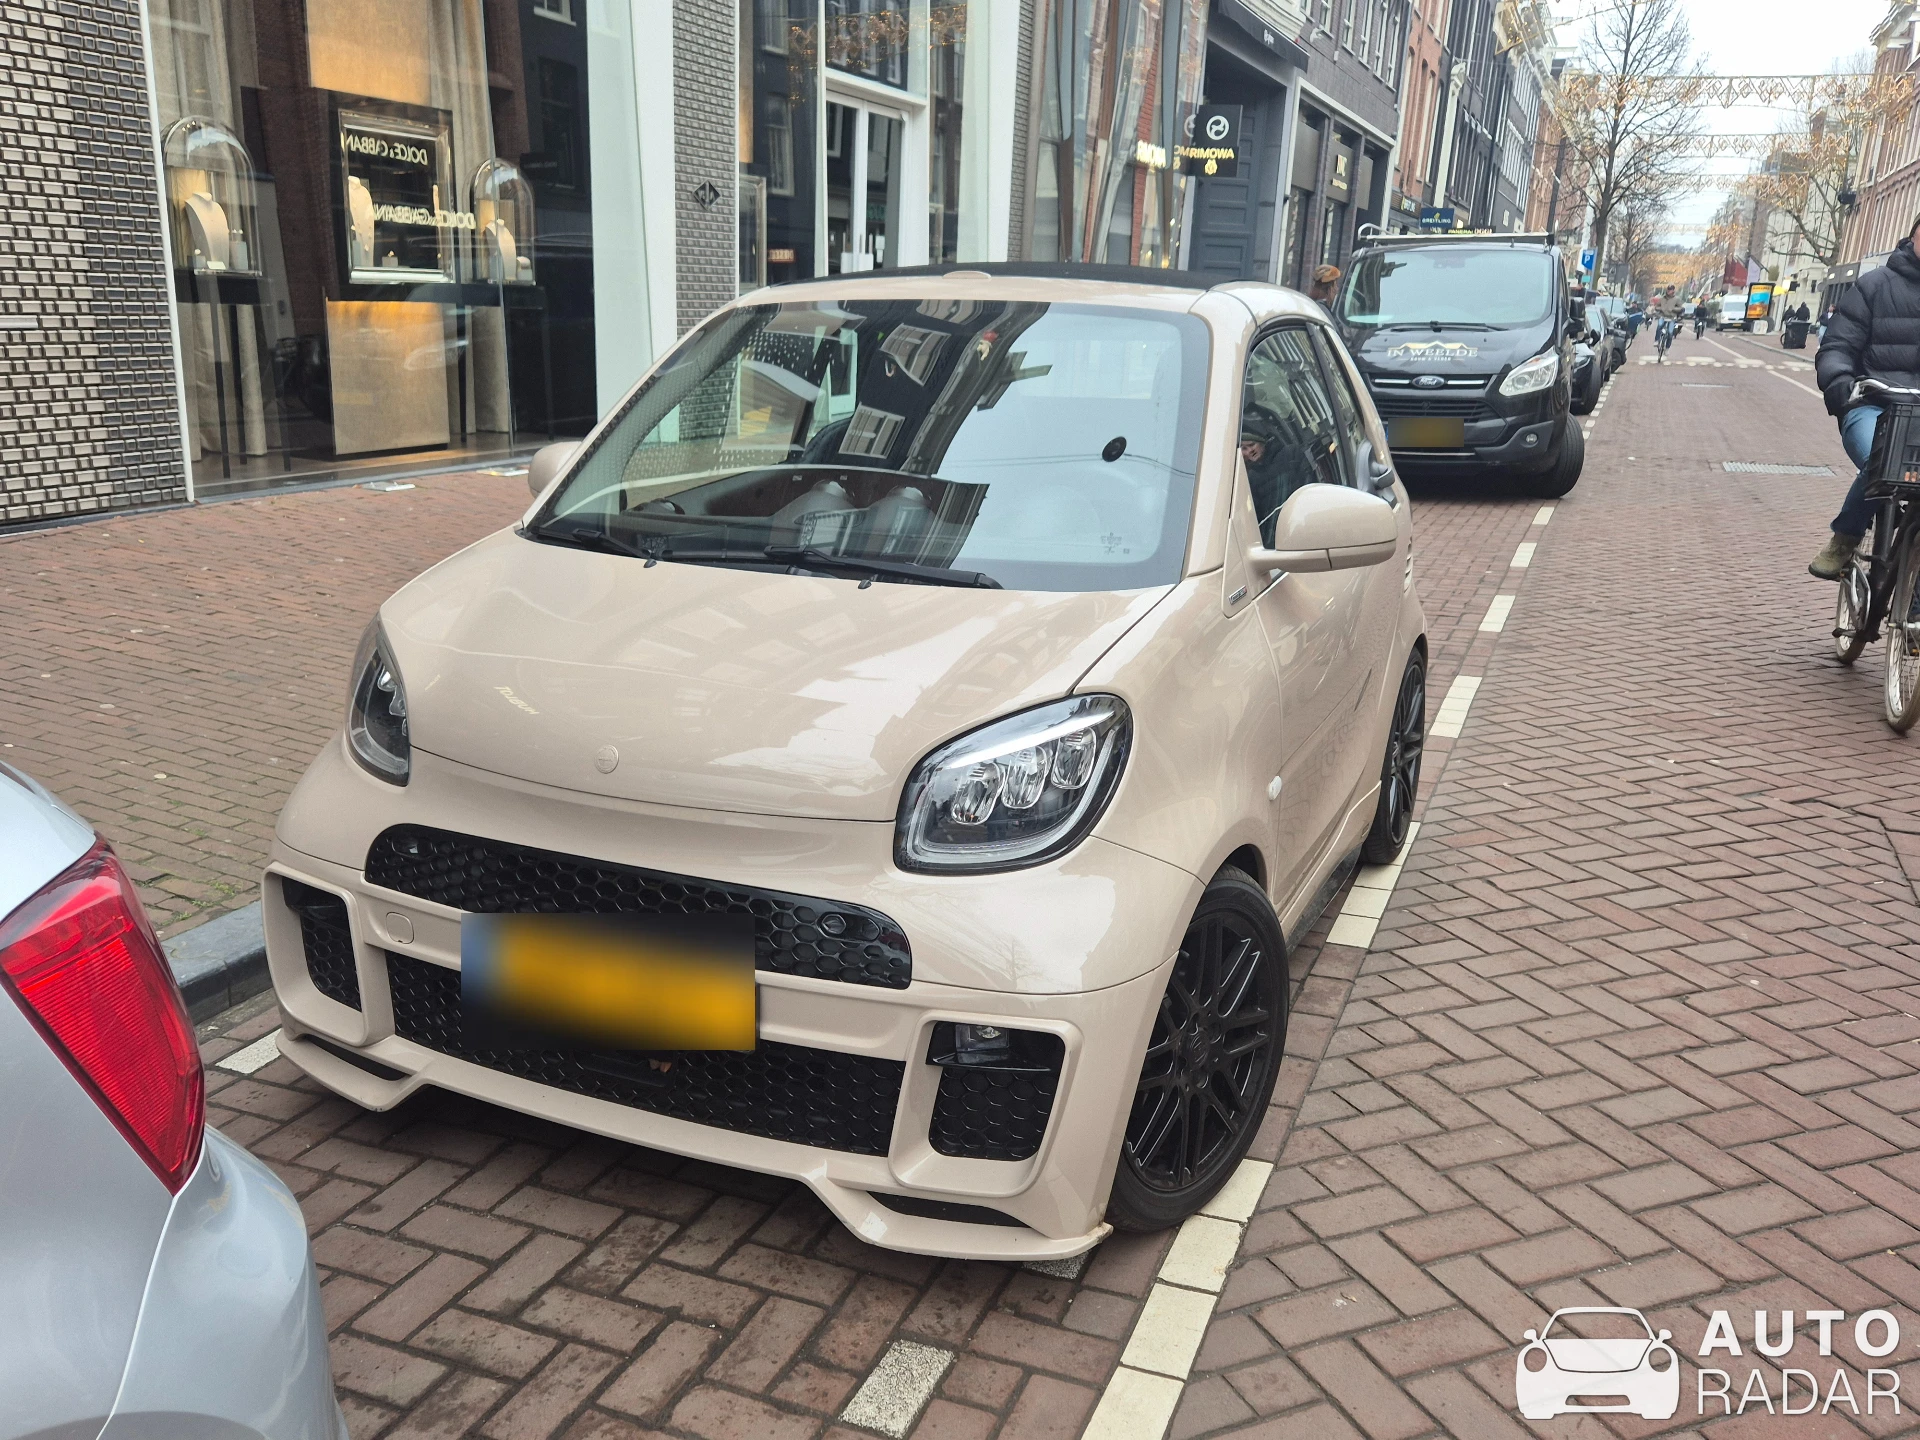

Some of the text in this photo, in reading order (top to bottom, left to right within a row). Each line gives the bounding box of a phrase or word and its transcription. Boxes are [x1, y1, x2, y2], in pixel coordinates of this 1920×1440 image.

[1189, 147, 1235, 159] RIMOWA
[1387, 348, 1478, 357] IN WEELDE
